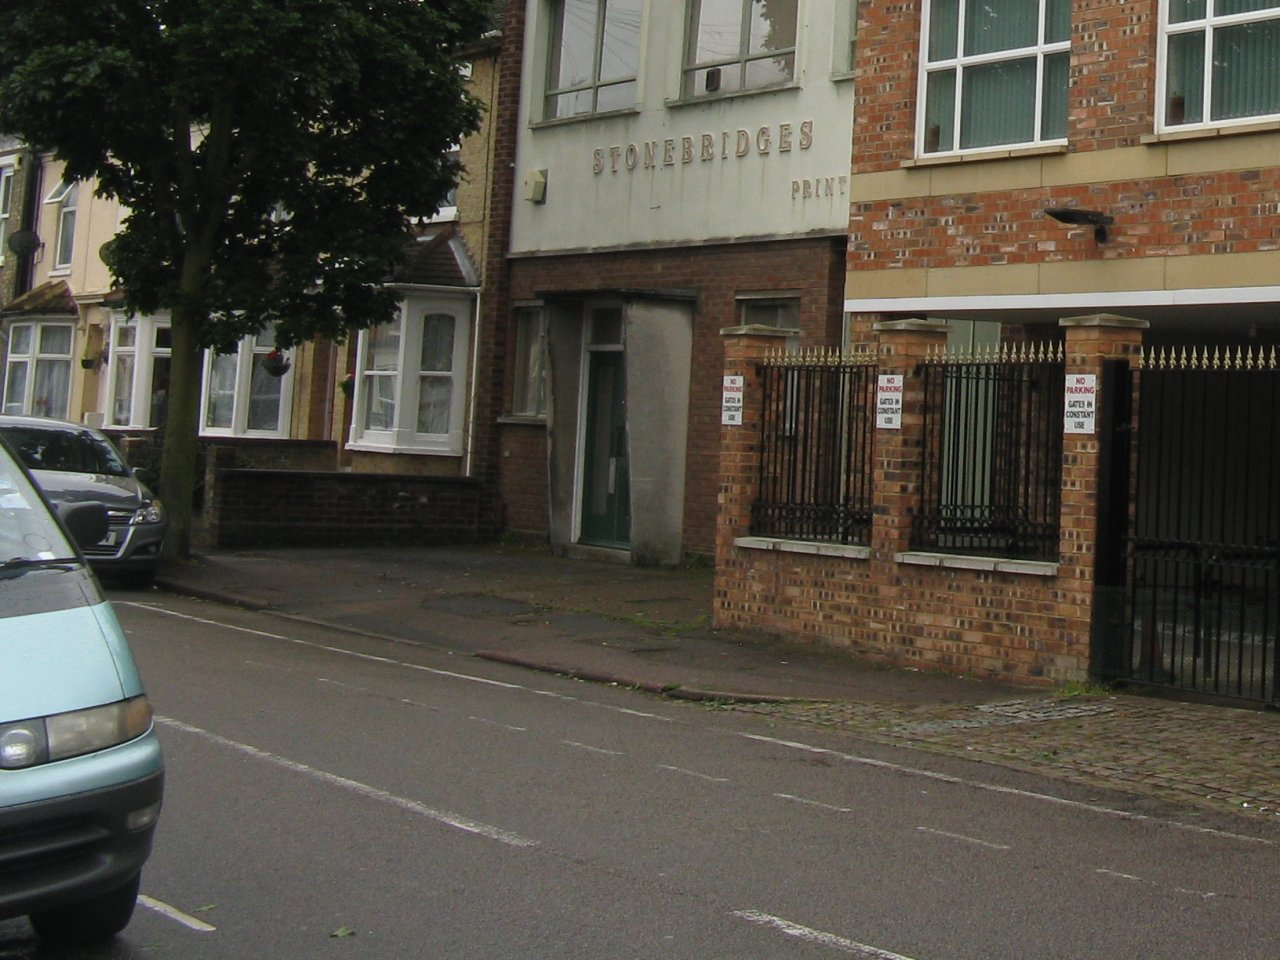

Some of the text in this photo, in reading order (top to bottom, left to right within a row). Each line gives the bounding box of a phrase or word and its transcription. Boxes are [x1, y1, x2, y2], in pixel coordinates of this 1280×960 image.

[592, 121, 813, 174] STONEBRIDGES
[791, 175, 847, 200] PRINT
[1075, 377, 1086, 385] NO
[1066, 386, 1095, 394] PARKING
[1068, 400, 1093, 409] GATES IN
[1066, 410, 1094, 419] CONSTANT
[1074, 421, 1086, 429] USE
